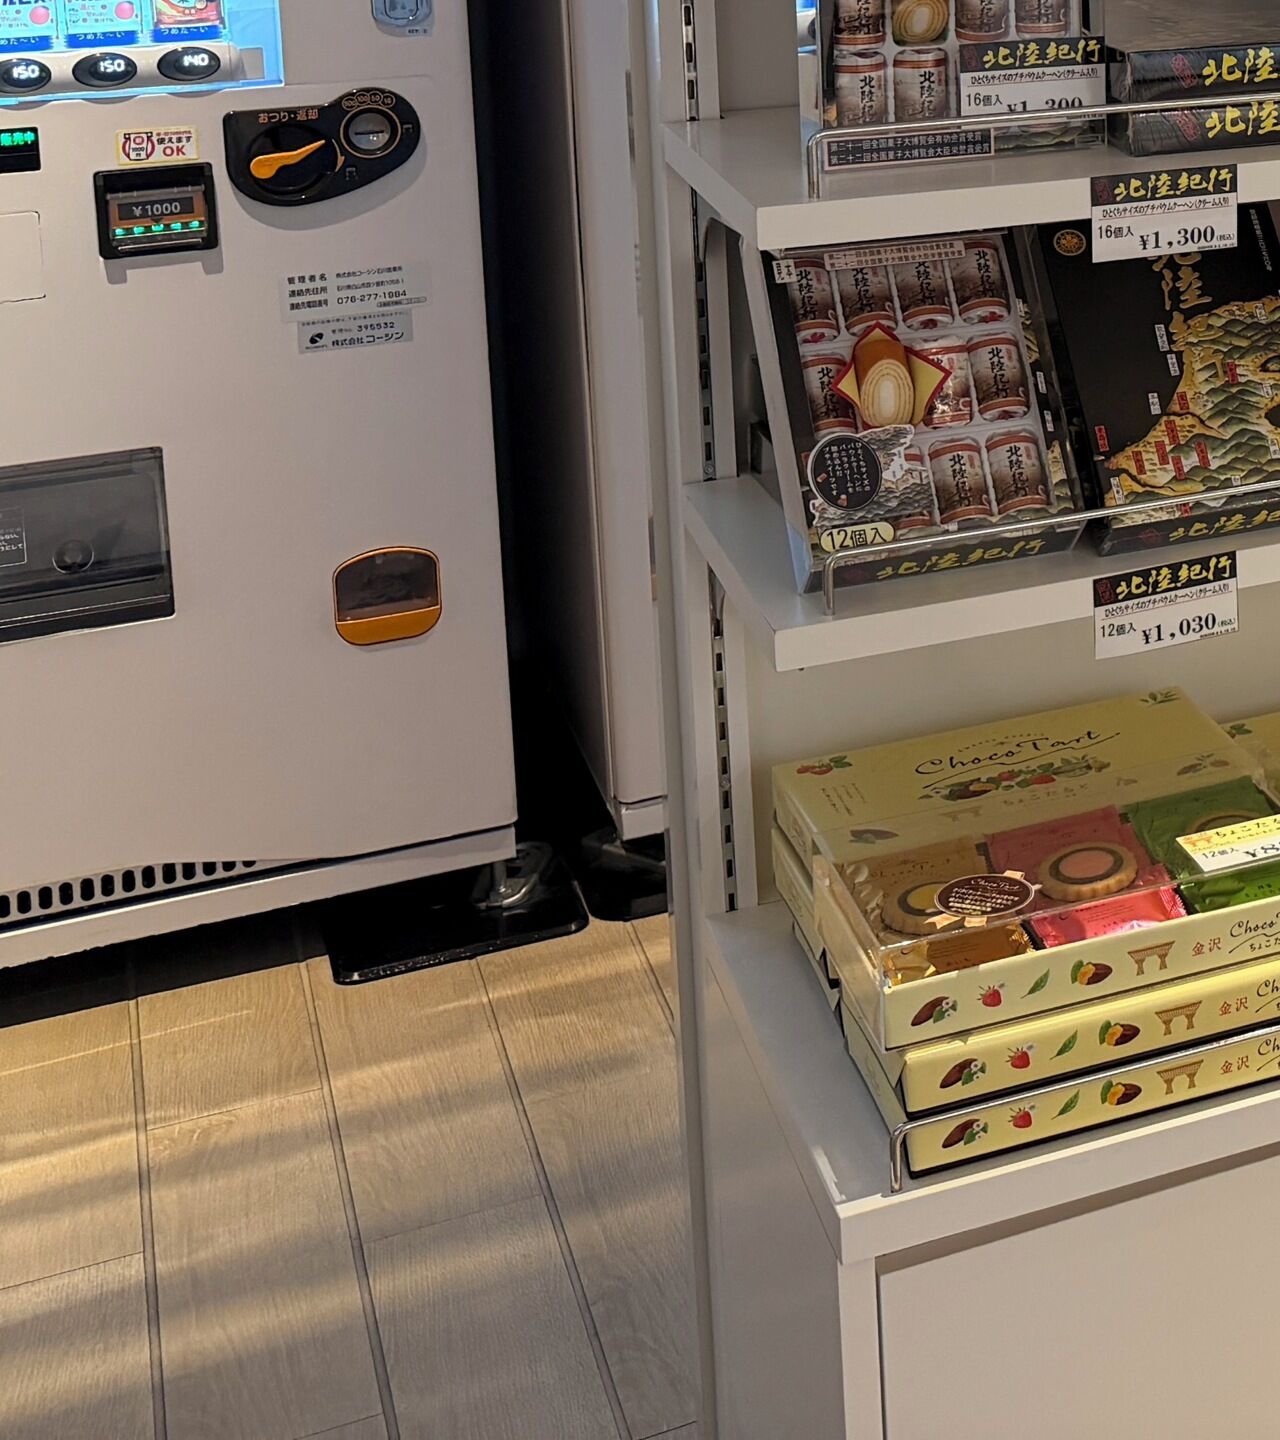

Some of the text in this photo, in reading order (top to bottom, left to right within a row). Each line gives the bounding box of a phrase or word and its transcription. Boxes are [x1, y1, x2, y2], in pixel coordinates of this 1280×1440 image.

[100, 60, 125, 72] 150
[982, 40, 1103, 68] 北陸紀行
[163, 145, 187, 158] OK
[1114, 167, 1234, 202] 北陸紀行
[1097, 225, 1216, 251] 16個入 ¥1,300
[826, 528, 888, 549] 12個入
[1115, 557, 1233, 601] 北陸紀行
[1100, 612, 1217, 646] 12個入 ¥1,030
[1192, 939, 1221, 956] 金沢
